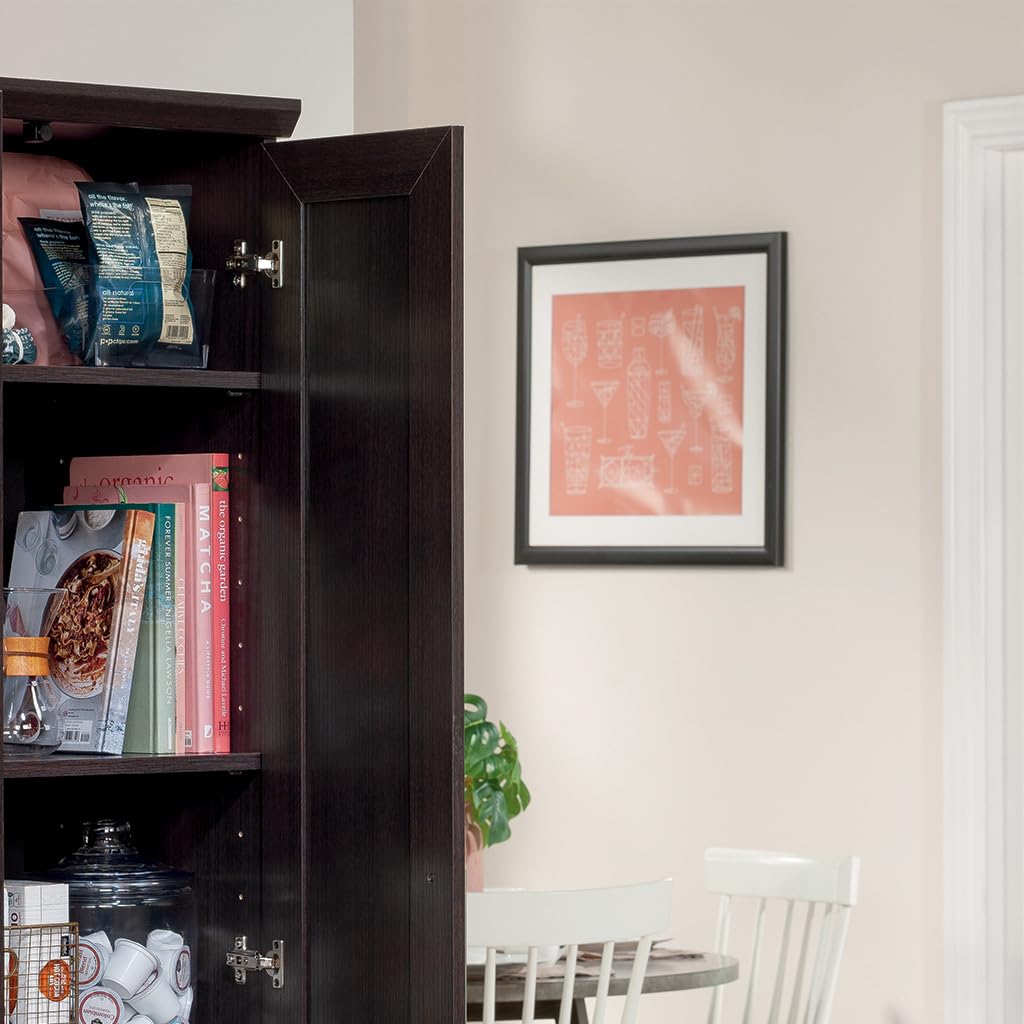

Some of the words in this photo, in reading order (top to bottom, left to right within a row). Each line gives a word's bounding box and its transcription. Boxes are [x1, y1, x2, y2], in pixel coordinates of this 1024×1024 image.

[219, 500, 227, 518] the
[164, 515, 172, 558] FOREVER
[216, 520, 227, 562] organic
[199, 505, 212, 614] MATCHA
[164, 561, 172, 602] SUMMER
[217, 563, 228, 602] garden
[83, 1008, 115, 1021] Colombian
